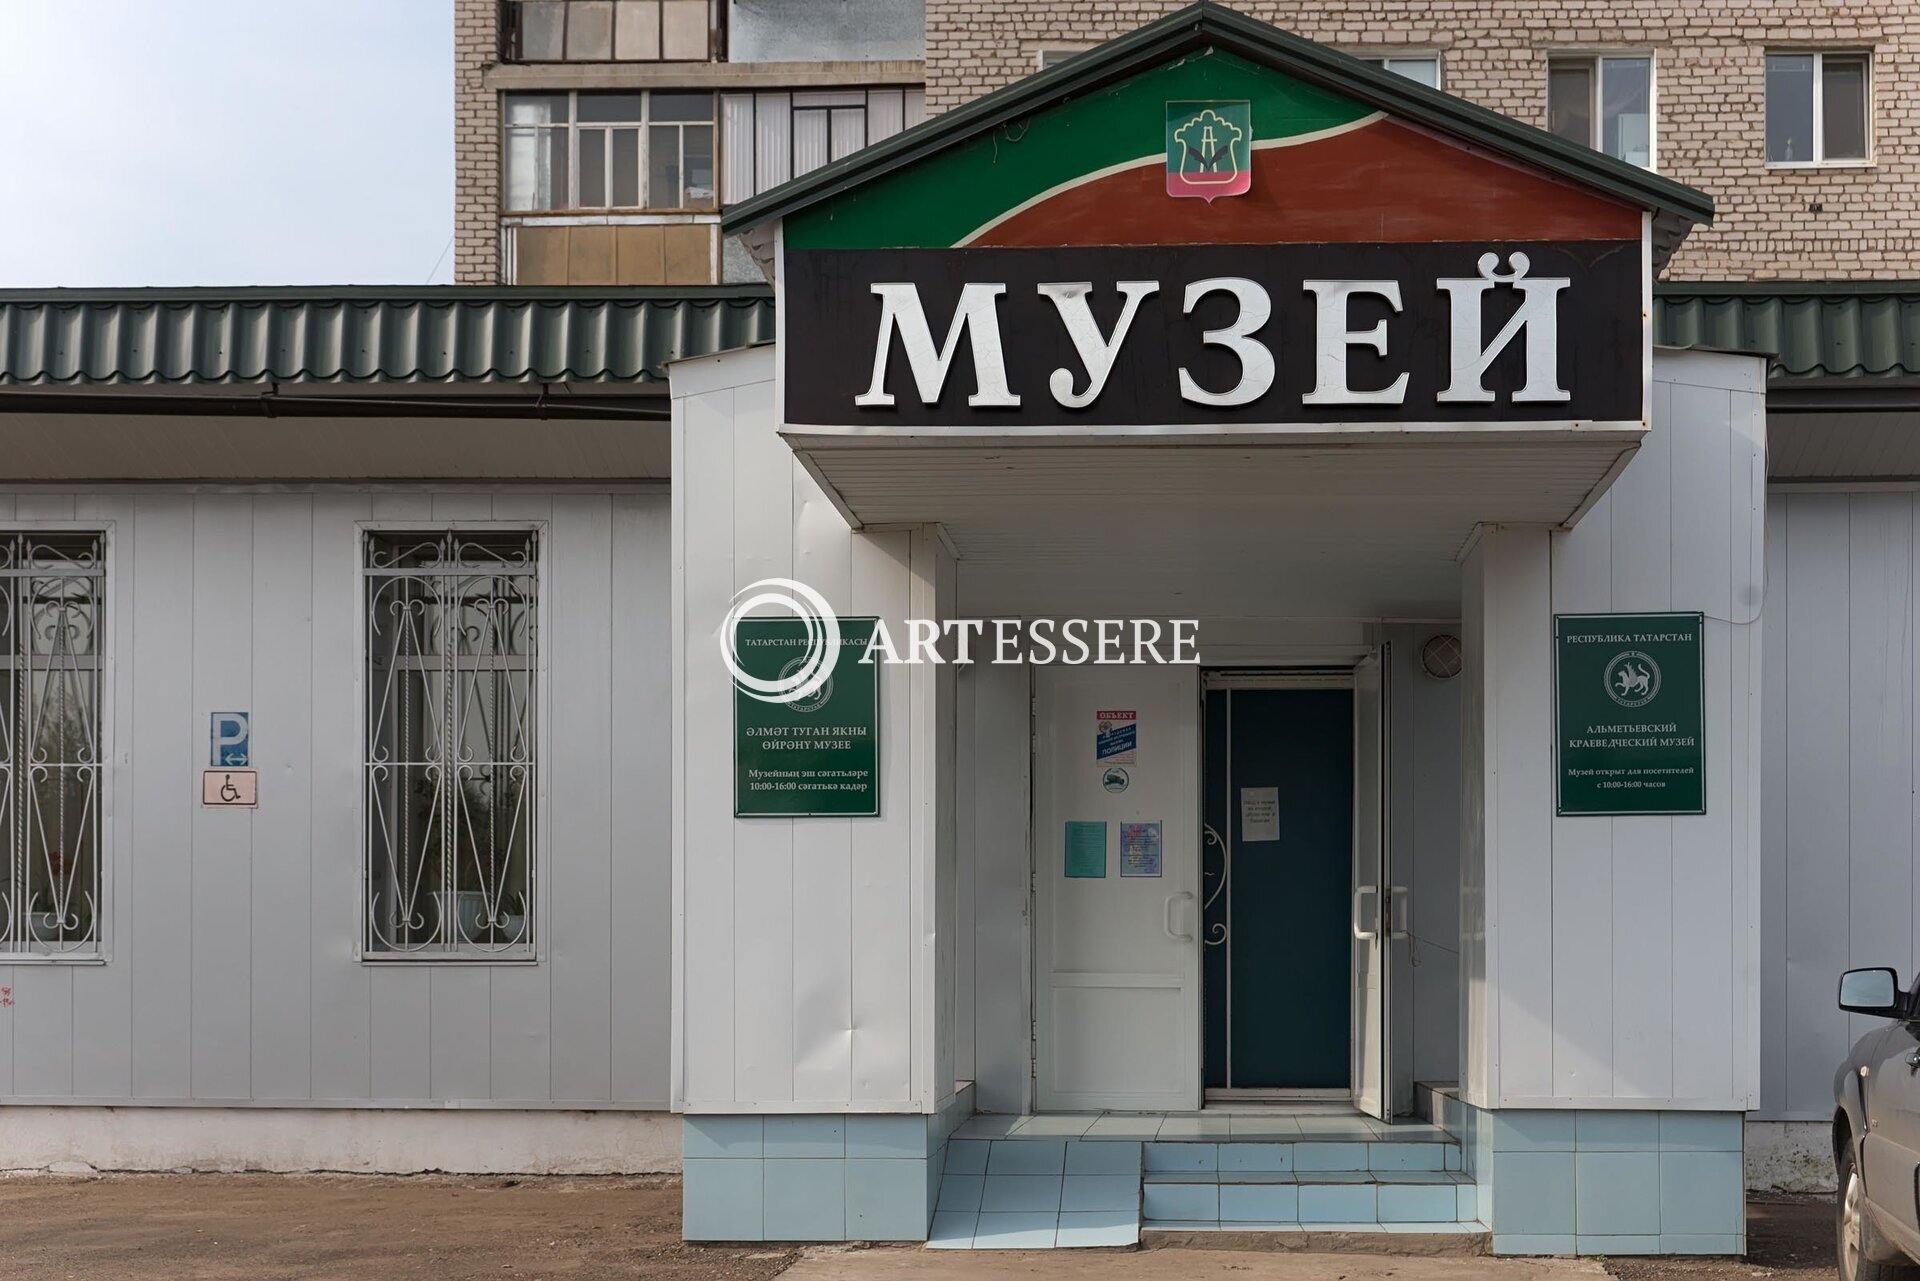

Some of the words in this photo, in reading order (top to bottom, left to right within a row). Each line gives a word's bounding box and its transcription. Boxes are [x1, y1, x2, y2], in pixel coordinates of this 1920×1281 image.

[853, 252, 1571, 408] МУЗЕЙ
[745, 638, 797, 646] ТАТАРСТАН
[798, 637, 868, 646] РЕПИКАСЫ
[1566, 634, 1631, 643] РЕСПУБЛИКА
[1633, 633, 1692, 642] ТАТАРСТАН
[746, 727, 789, 737] ӘЛМӘТ
[792, 727, 829, 736] ТУГАН
[832, 726, 867, 736] ЯКНЫ
[1586, 722, 1677, 734] АЛЬМЕТЬЕВСКИЙ
[212, 713, 248, 766] P
[813, 740, 851, 750] МУЗЕЕ
[1569, 736, 1658, 748] КРАЕВЕДЧЕСКИЙ
[1660, 736, 1695, 747] МУЗЕЙ
[802, 770, 816, 778] эш
[1568, 768, 1594, 778] Музей
[1595, 769, 1626, 777] открыт
[1643, 767, 1694, 775] посетителей
[750, 782, 797, 791] 10:00-16:00
